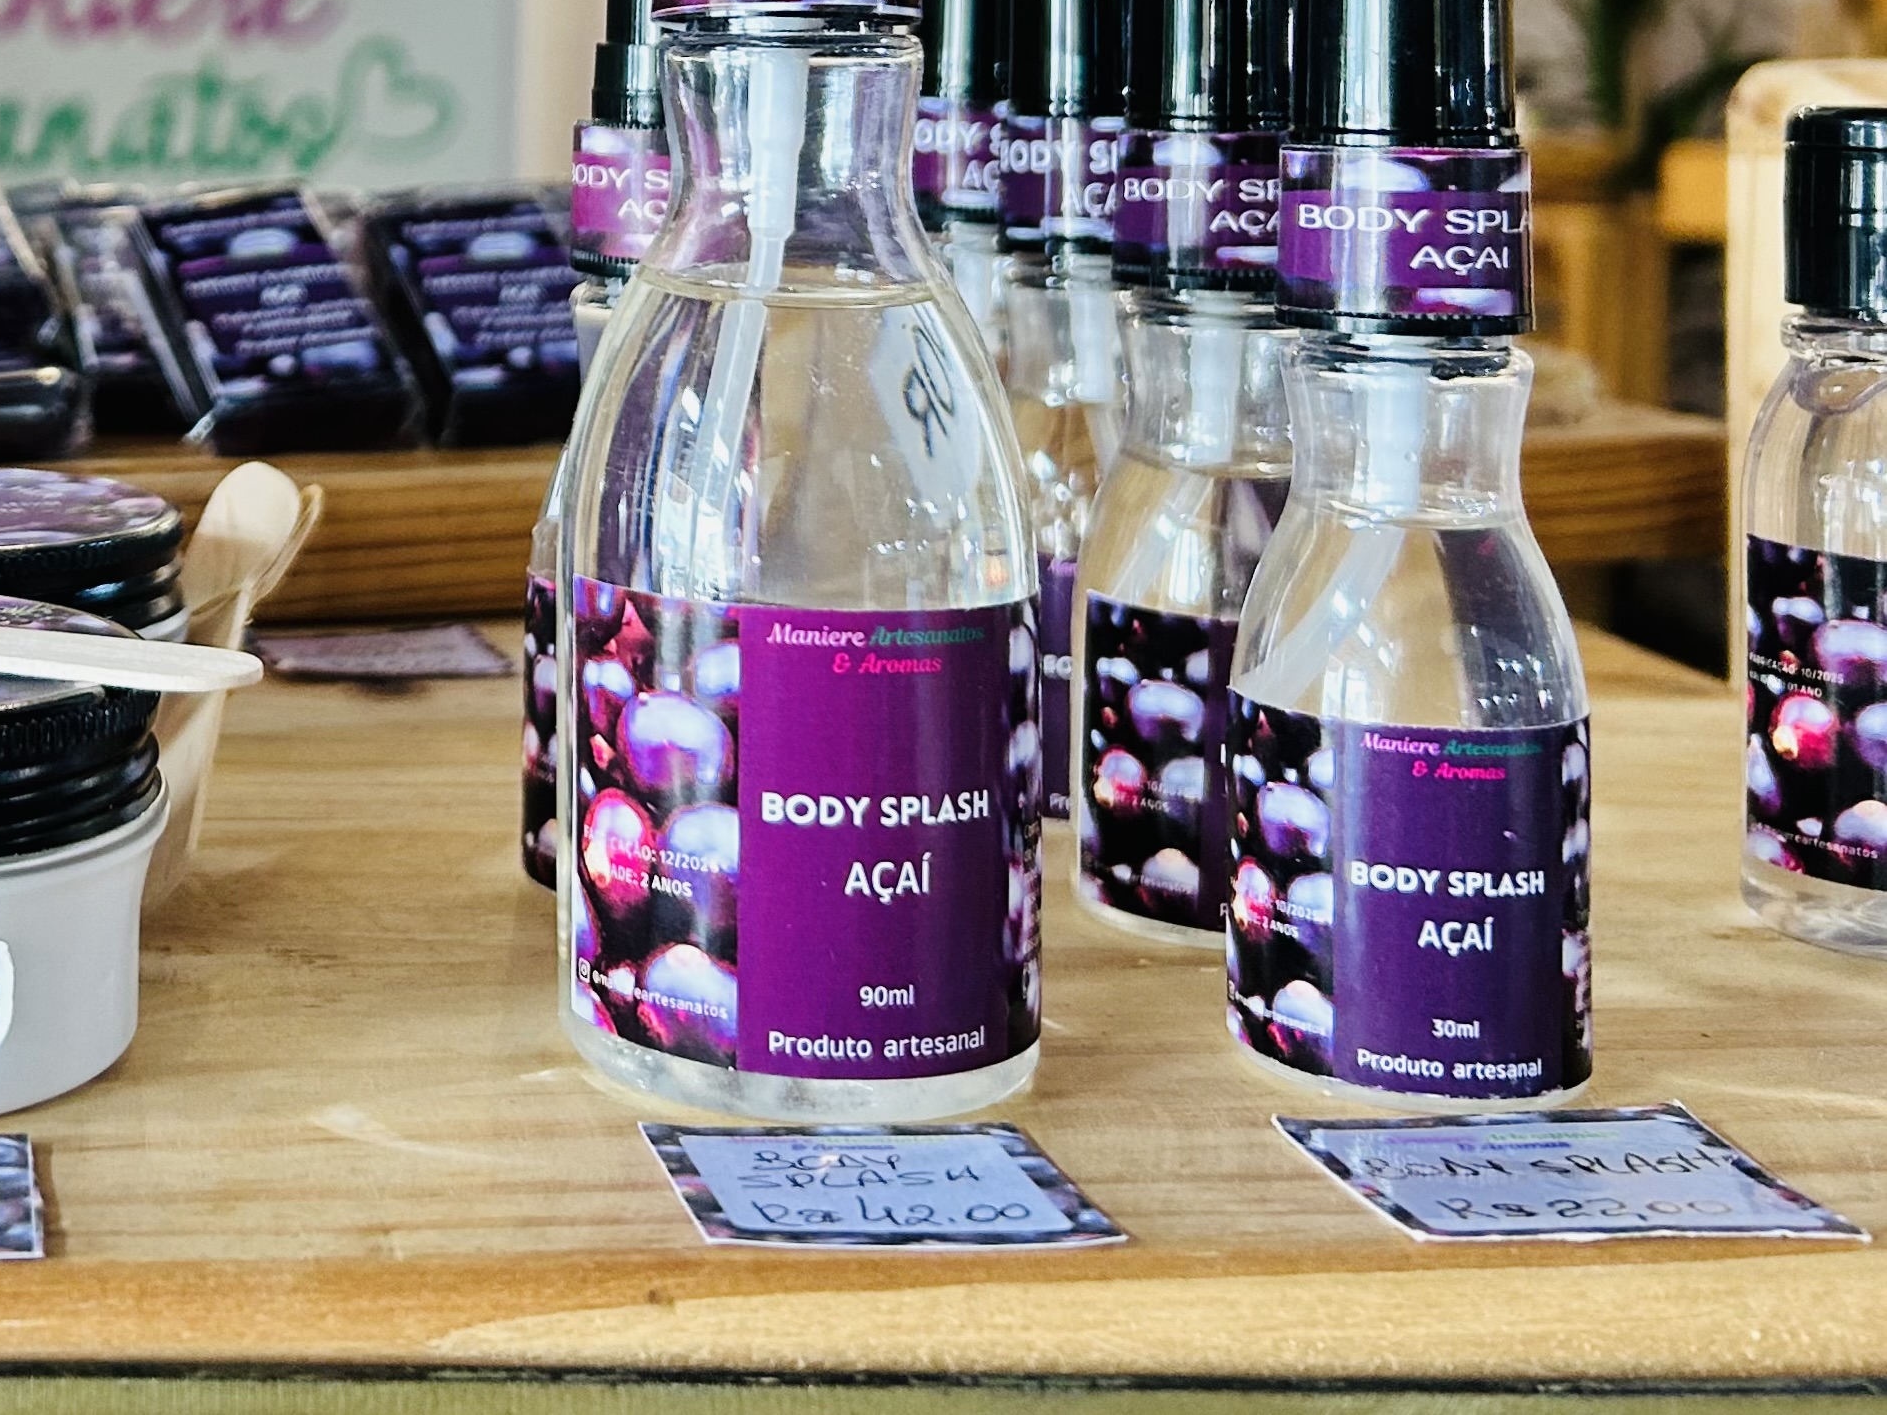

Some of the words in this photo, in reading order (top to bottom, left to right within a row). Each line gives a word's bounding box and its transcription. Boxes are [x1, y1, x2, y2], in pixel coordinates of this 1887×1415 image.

[913, 118, 984, 155] ODY
[1123, 177, 1225, 202] BODY
[1298, 203, 1428, 234] BODY
[1410, 245, 1510, 277] AÇAI
[766, 621, 866, 648] Maniere
[832, 652, 851, 674] &
[858, 652, 943, 675] Aromas
[1360, 732, 1441, 756] Maniere
[1412, 760, 1429, 778] &
[1434, 761, 1506, 780] Aromas
[760, 792, 869, 828] BODY
[879, 790, 990, 826] SPLASH
[651, 874, 694, 898] ANOS
[844, 853, 932, 904] AÇAÍ
[1350, 861, 1439, 896] BODY
[1447, 870, 1546, 897] SPLASH
[1418, 916, 1494, 956] AÇAÍ
[859, 985, 915, 1008] 90ml
[1431, 1018, 1481, 1040] 30ml
[768, 1030, 873, 1060] Produto
[883, 1027, 986, 1060] artesanal
[1357, 1048, 1445, 1078] Produto
[1453, 1057, 1543, 1081] artesanal
[1529, 1147, 1723, 1175] SPLASH
[738, 1164, 981, 1190] SPLASH
